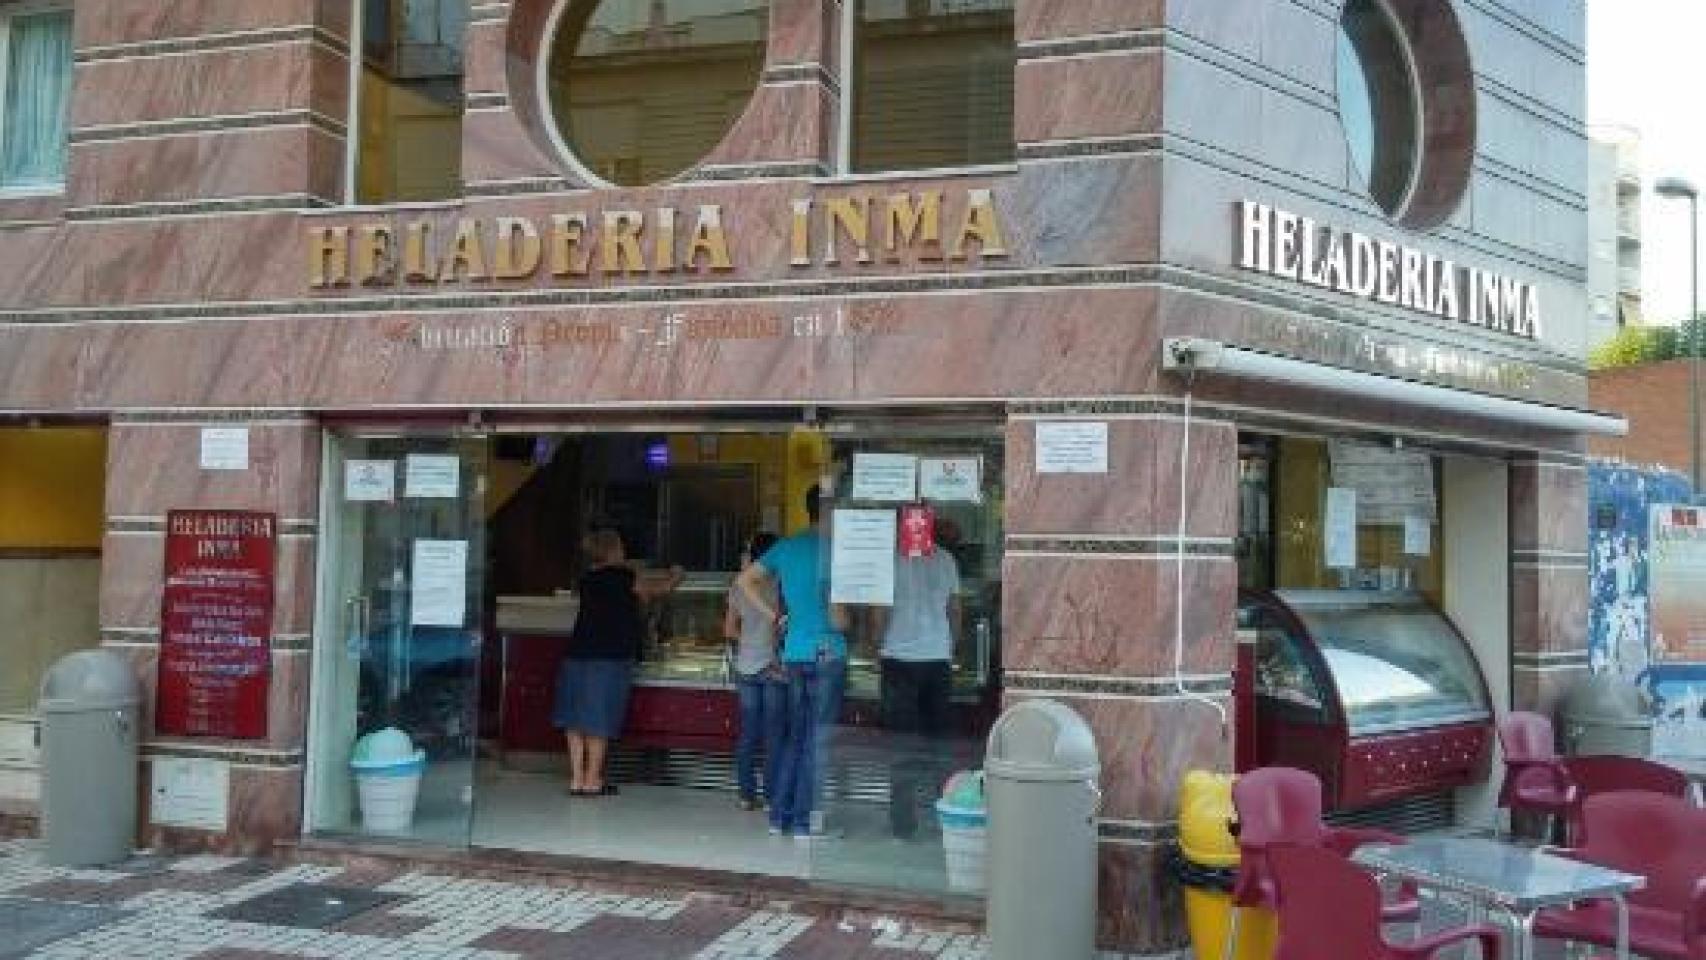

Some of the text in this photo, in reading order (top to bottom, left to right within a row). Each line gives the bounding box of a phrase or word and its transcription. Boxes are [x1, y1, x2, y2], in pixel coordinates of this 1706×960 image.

[305, 188, 1009, 290] HELADERIA INMA
[1236, 199, 1459, 320] HELADERIA
[1465, 265, 1542, 341] INMA
